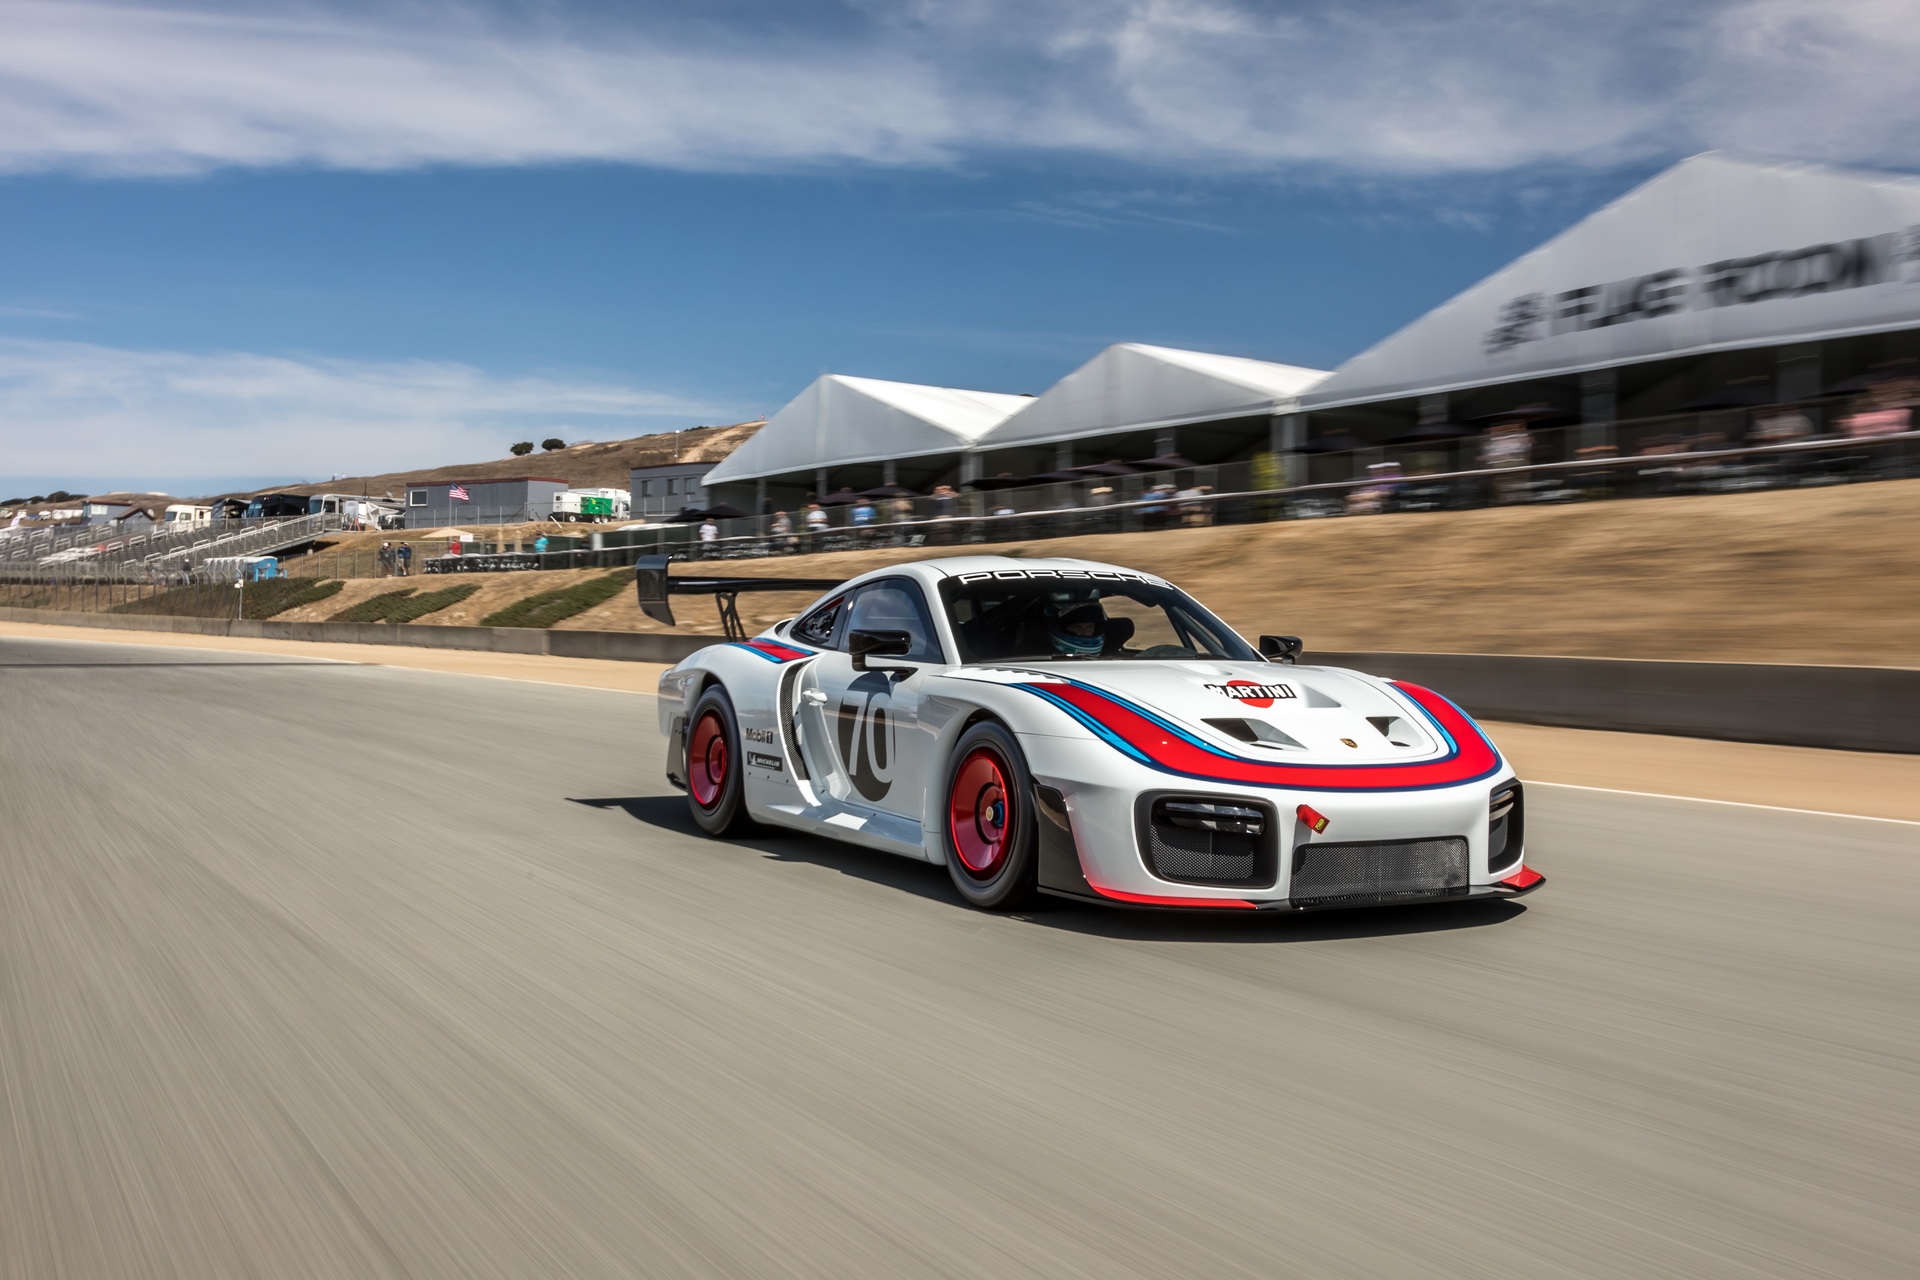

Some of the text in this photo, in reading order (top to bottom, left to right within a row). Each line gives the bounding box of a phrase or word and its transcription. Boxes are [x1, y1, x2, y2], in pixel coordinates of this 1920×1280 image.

[958, 569, 1175, 591] PORSCHE
[1204, 684, 1294, 699] MARTINI
[840, 689, 896, 784] 70
[757, 757, 780, 767] MICHELIN
